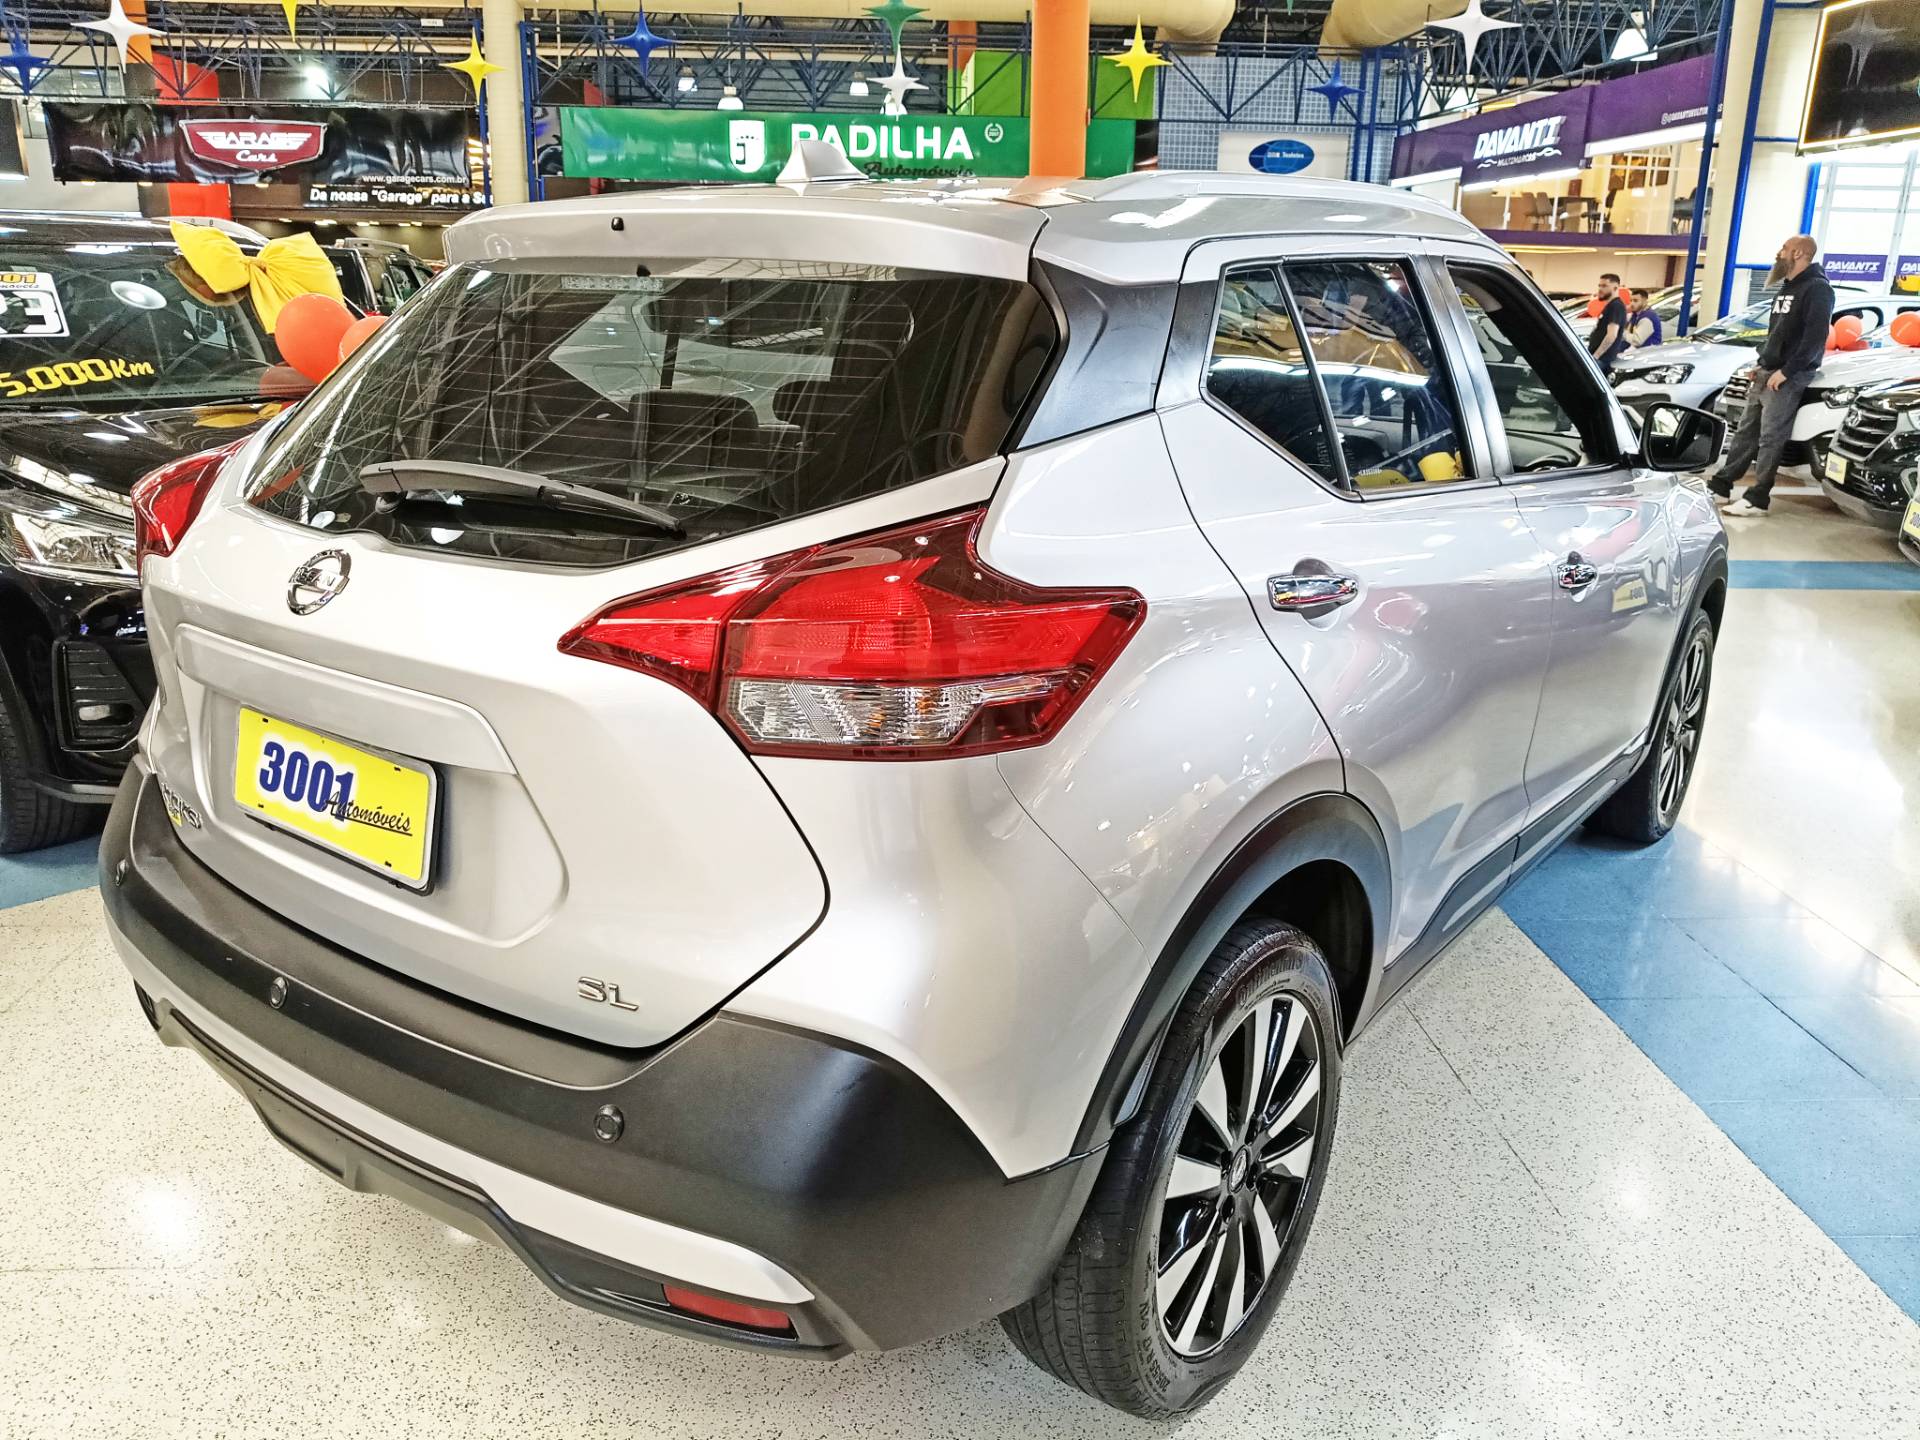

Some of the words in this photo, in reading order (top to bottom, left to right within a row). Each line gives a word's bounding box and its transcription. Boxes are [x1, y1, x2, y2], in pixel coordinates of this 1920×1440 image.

[196, 131, 313, 150] GARAGE
[791, 123, 974, 160] PADILHA
[1474, 115, 1566, 160] DAVANTI
[236, 150, 278, 162] Cars
[362, 174, 468, 184] www.garagecars.com.br
[310, 188, 327, 202] Da
[330, 190, 368, 202] nossa
[431, 191, 459, 206] para
[461, 193, 470, 204] a
[1825, 261, 1880, 271] DAVANTI
[0, 272, 37, 284] 01
[259, 741, 354, 822] 3001
[325, 791, 412, 832] Automóveis
[577, 976, 640, 1012] SL
